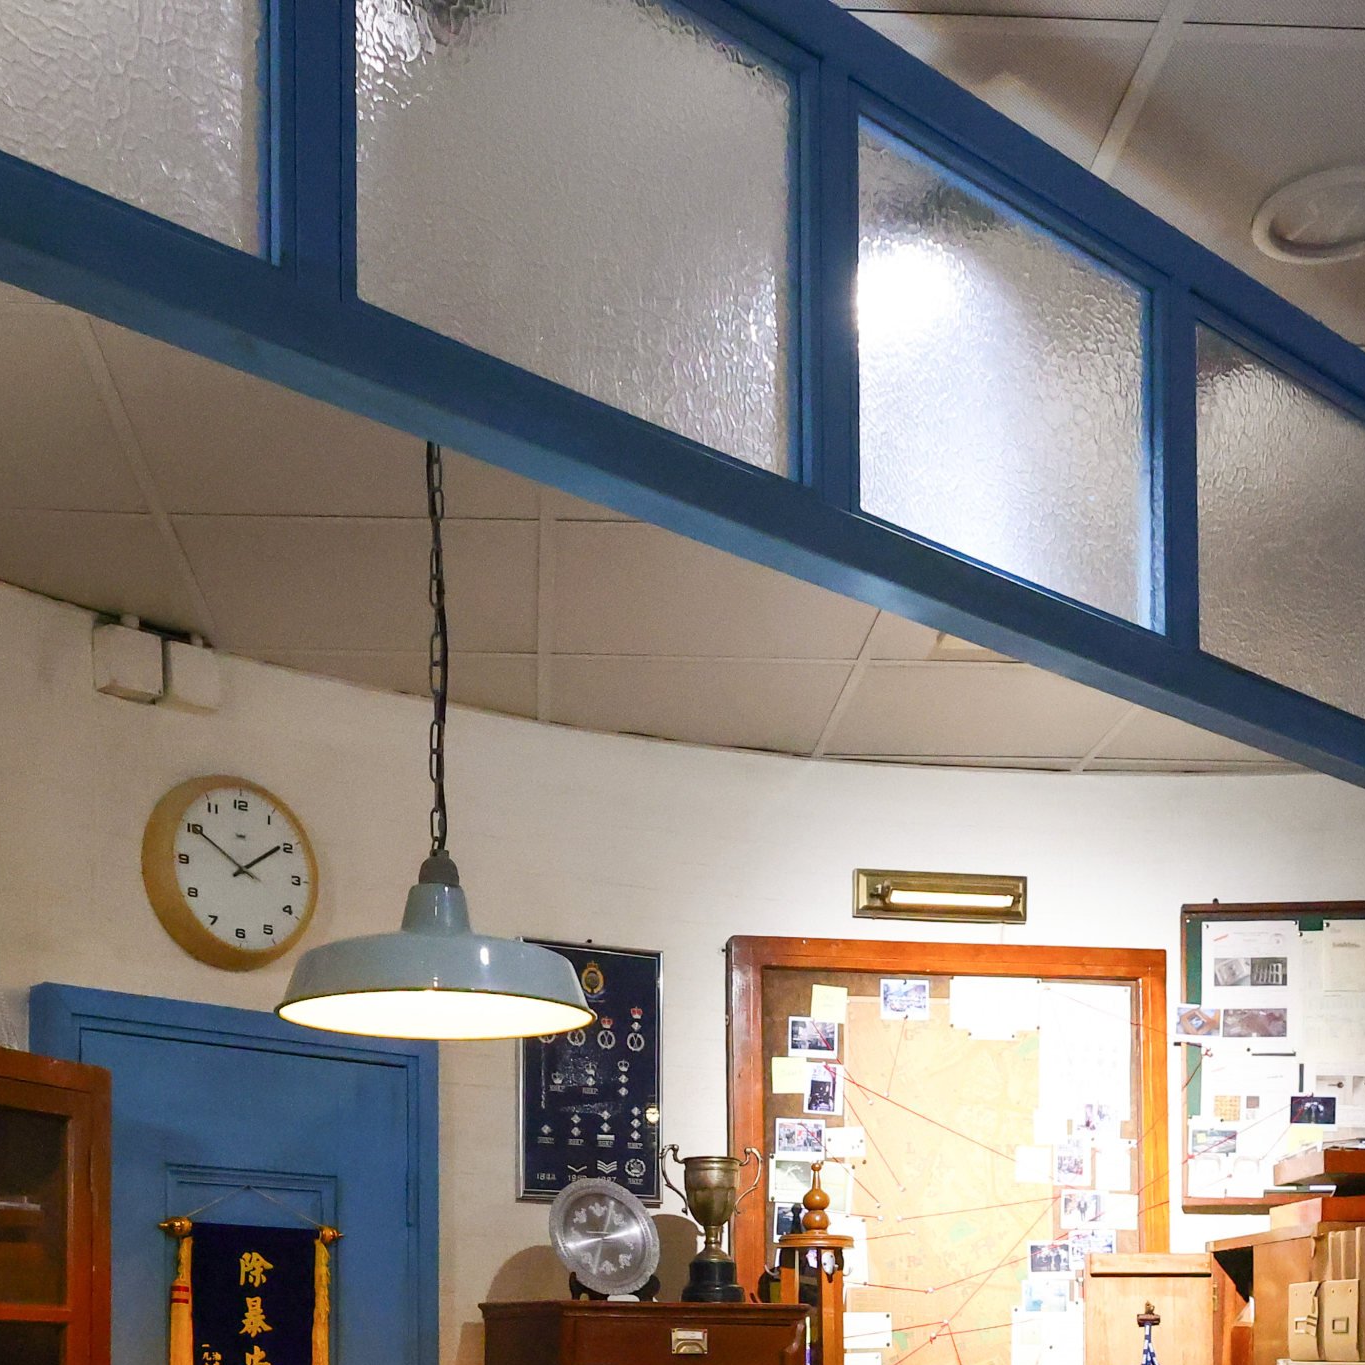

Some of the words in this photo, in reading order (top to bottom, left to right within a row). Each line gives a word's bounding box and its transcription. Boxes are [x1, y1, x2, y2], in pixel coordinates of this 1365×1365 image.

[207, 802, 218, 814] 11
[233, 799, 249, 811] 12
[267, 815, 271, 825] 1
[187, 823, 203, 834] 10
[282, 843, 293, 854] 2
[178, 854, 189, 864] 9
[291, 876, 301, 887] 3
[187, 887, 198, 898] 8
[282, 904, 293, 915] 4
[208, 915, 219, 926] 7
[235, 928, 246, 939] 6
[263, 924, 273, 935] 5
